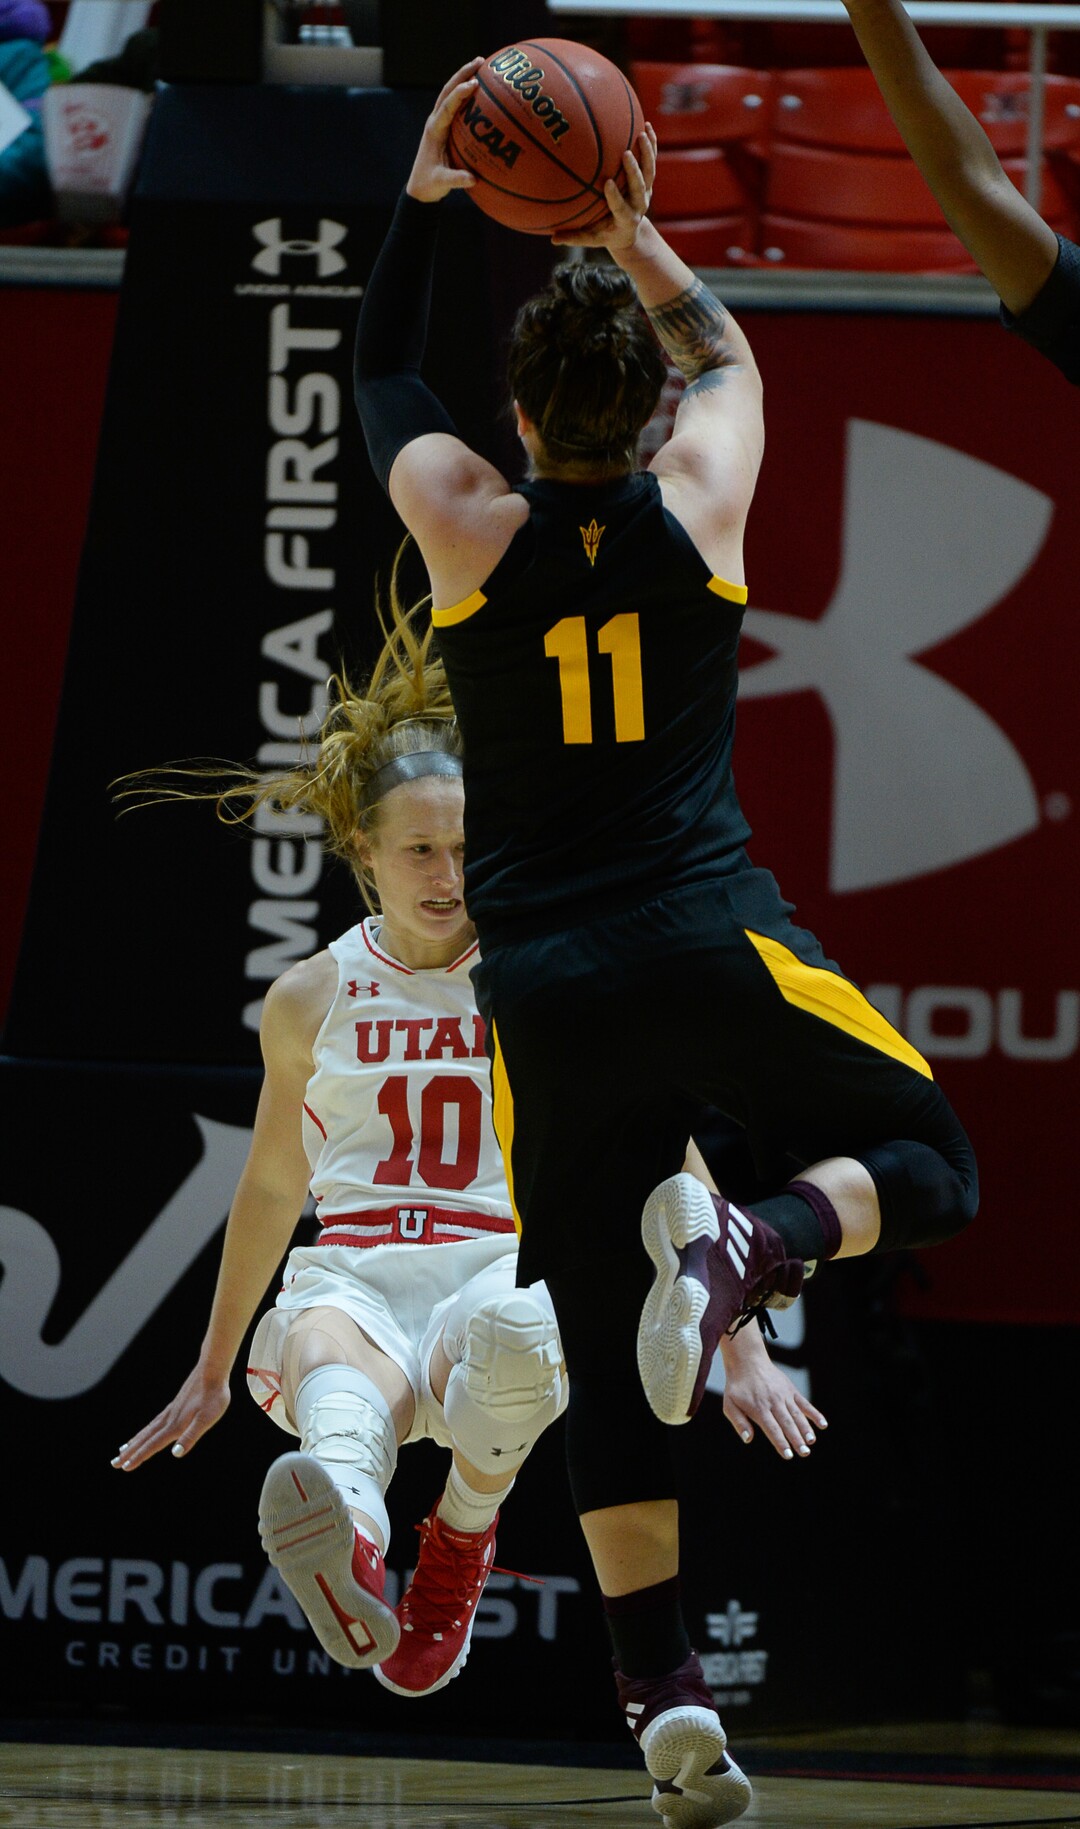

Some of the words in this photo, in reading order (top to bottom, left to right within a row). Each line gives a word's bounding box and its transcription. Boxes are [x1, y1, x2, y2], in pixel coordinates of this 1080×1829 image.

[459, 96, 523, 169] NCAA
[487, 47, 571, 143] Wilson
[265, 302, 342, 590] FIRST
[544, 612, 646, 744] 11
[372, 1075, 483, 1191] 10
[65, 1641, 240, 1672] CREDIT
